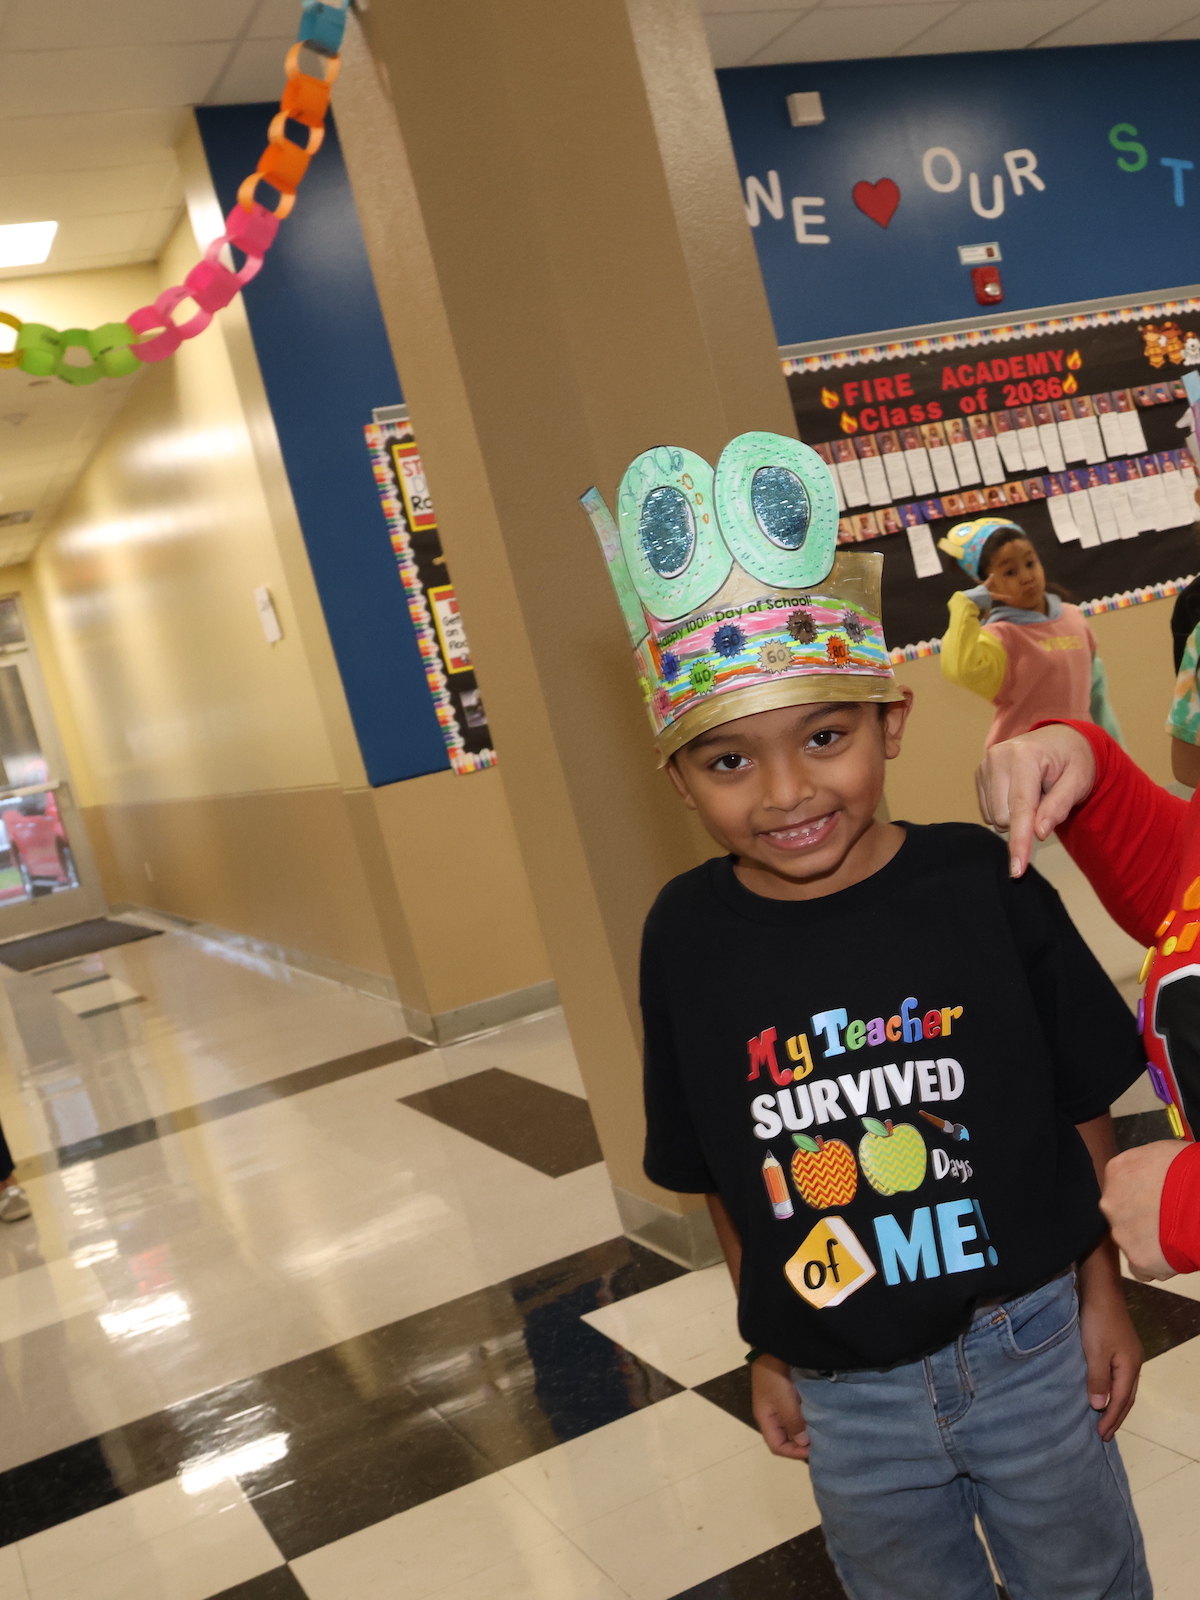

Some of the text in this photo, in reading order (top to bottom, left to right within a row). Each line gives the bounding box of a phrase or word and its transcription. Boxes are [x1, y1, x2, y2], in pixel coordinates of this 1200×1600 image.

[922, 147, 1045, 219] OUR
[842, 349, 1065, 406] FIRE ACADEMY
[858, 376, 1063, 432] Class of 2036
[686, 614, 713, 633] 100th
[715, 606, 743, 623] Day
[748, 601, 763, 613] of
[766, 595, 812, 610] School!
[721, 633, 741, 648] 50
[767, 649, 786, 663] 60
[833, 645, 845, 658] 80
[694, 669, 711, 684] 40
[747, 997, 964, 1086] My Teacher
[750, 1057, 966, 1140] SURVIVED
[931, 1148, 974, 1183] Days
[803, 1238, 841, 1290] of
